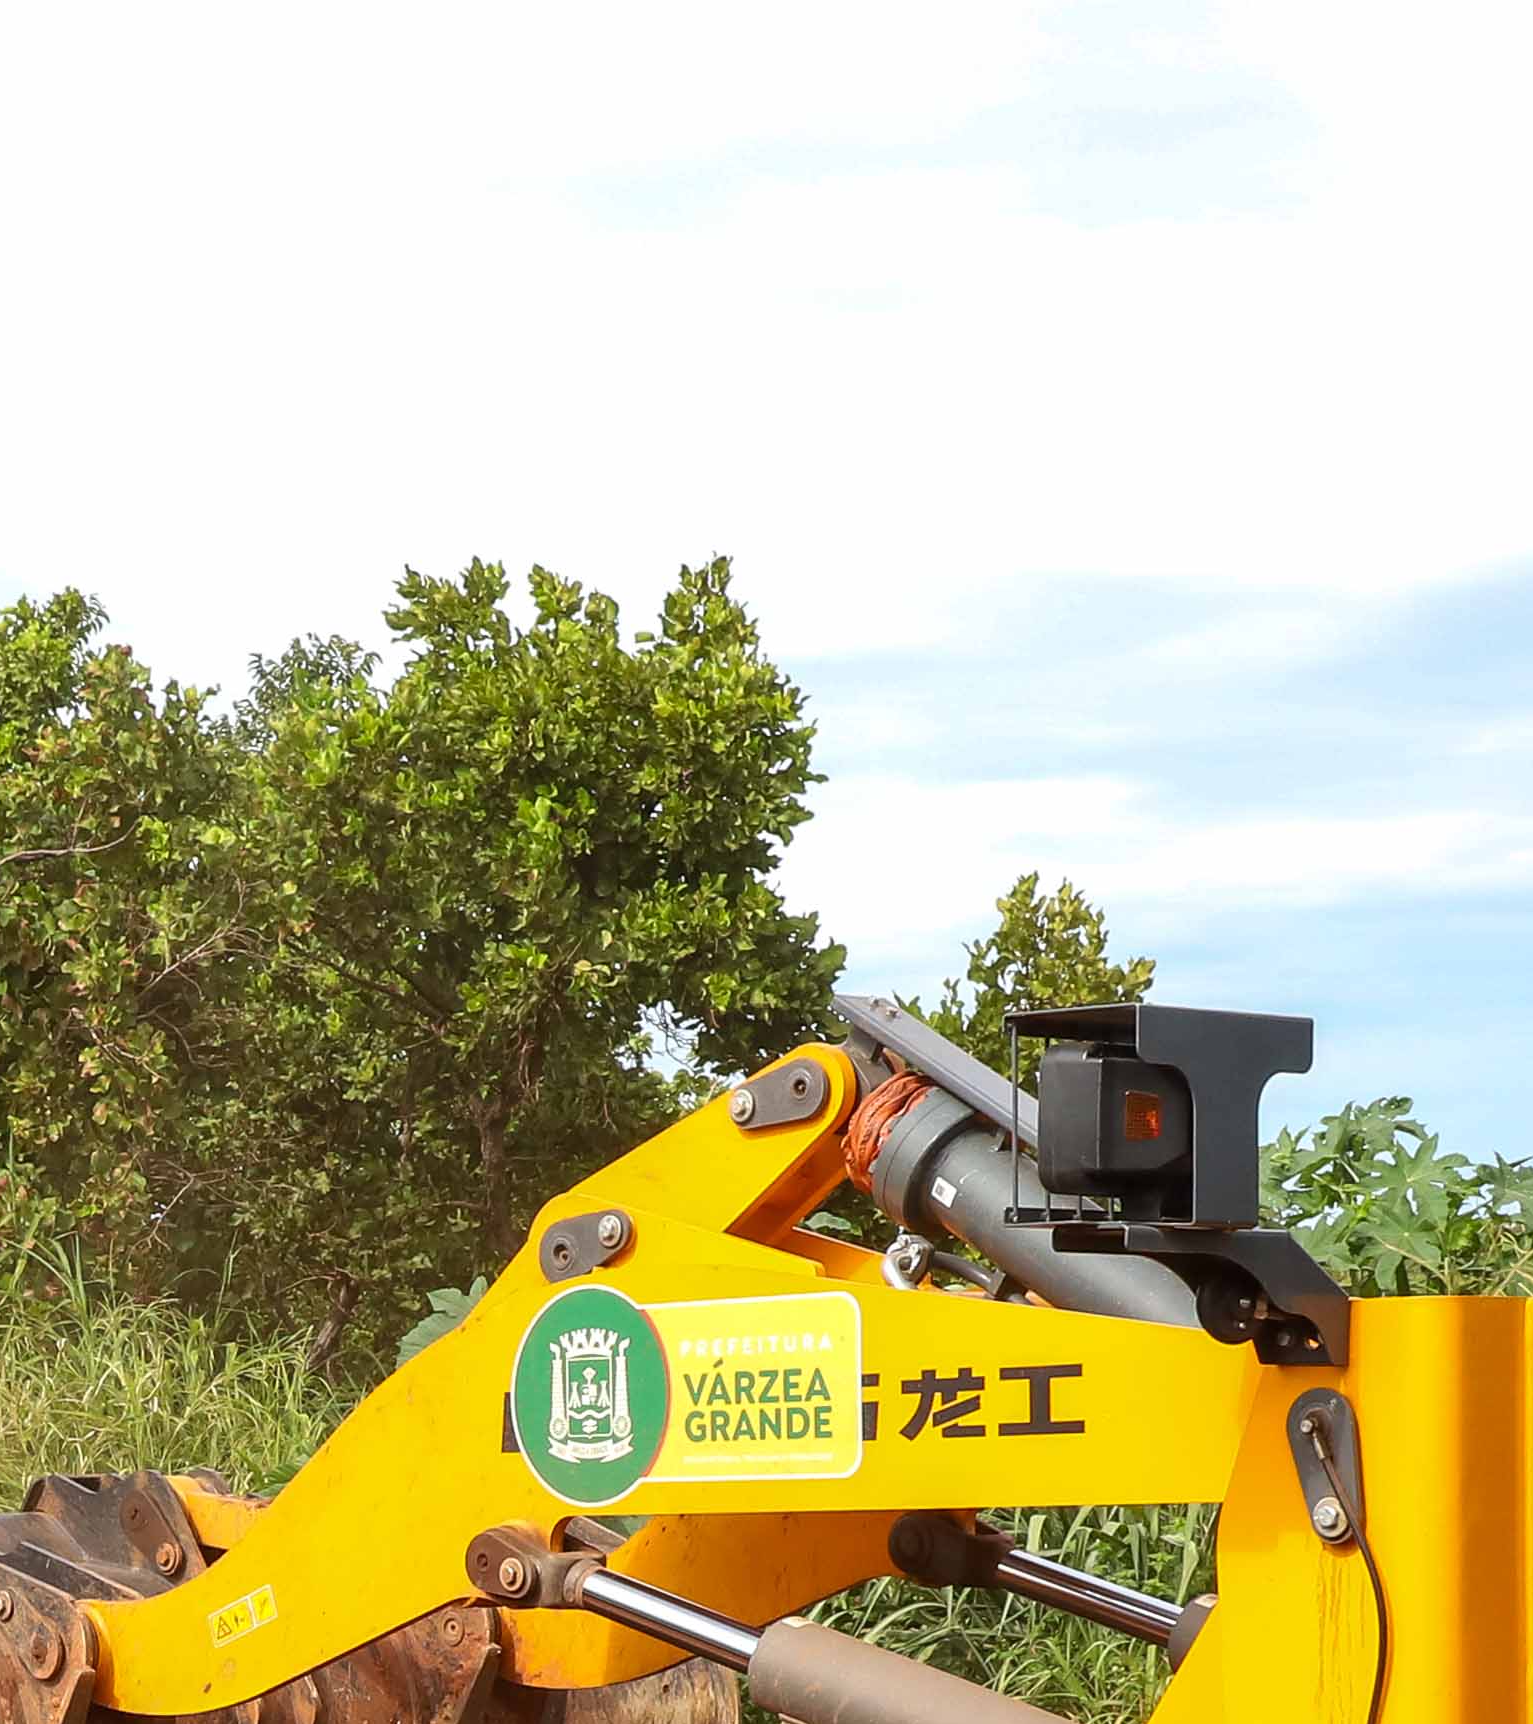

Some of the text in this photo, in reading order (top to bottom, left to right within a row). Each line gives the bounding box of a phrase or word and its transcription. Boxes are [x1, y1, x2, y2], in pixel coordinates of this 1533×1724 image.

[680, 1332, 833, 1358] PREFEITURA
[683, 1358, 831, 1406] VÁRZEA
[684, 1405, 833, 1442] GRANDE
